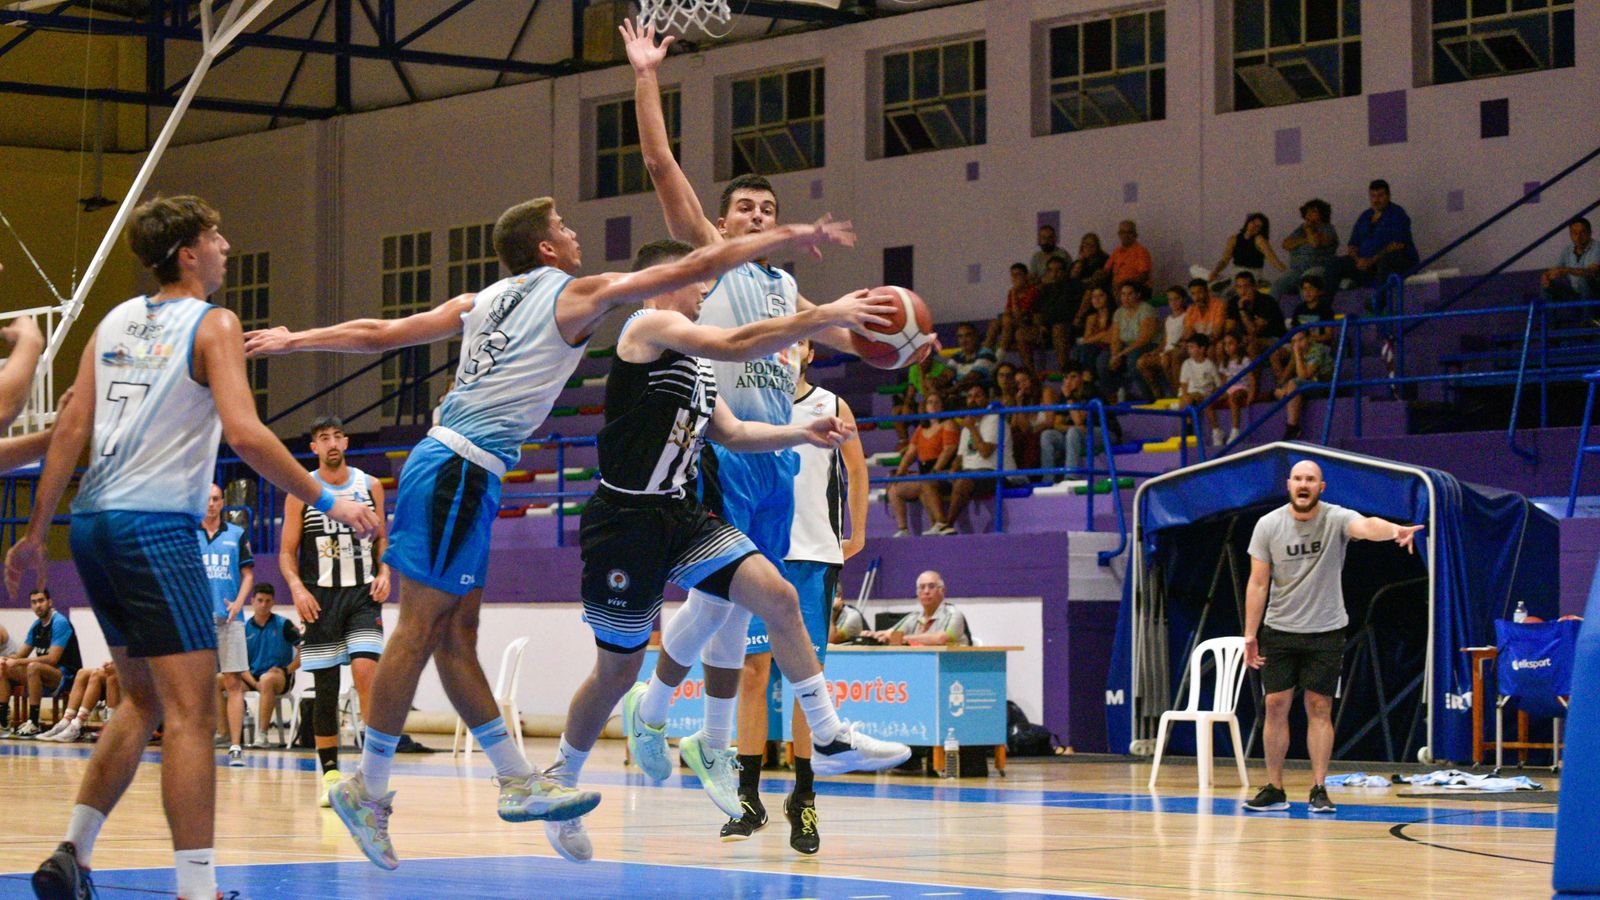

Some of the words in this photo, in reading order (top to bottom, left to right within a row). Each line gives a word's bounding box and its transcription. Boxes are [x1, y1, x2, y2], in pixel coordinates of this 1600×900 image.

[101, 381, 151, 456] 7
[1286, 541, 1321, 556] ULB
[825, 676, 909, 709] eportes
